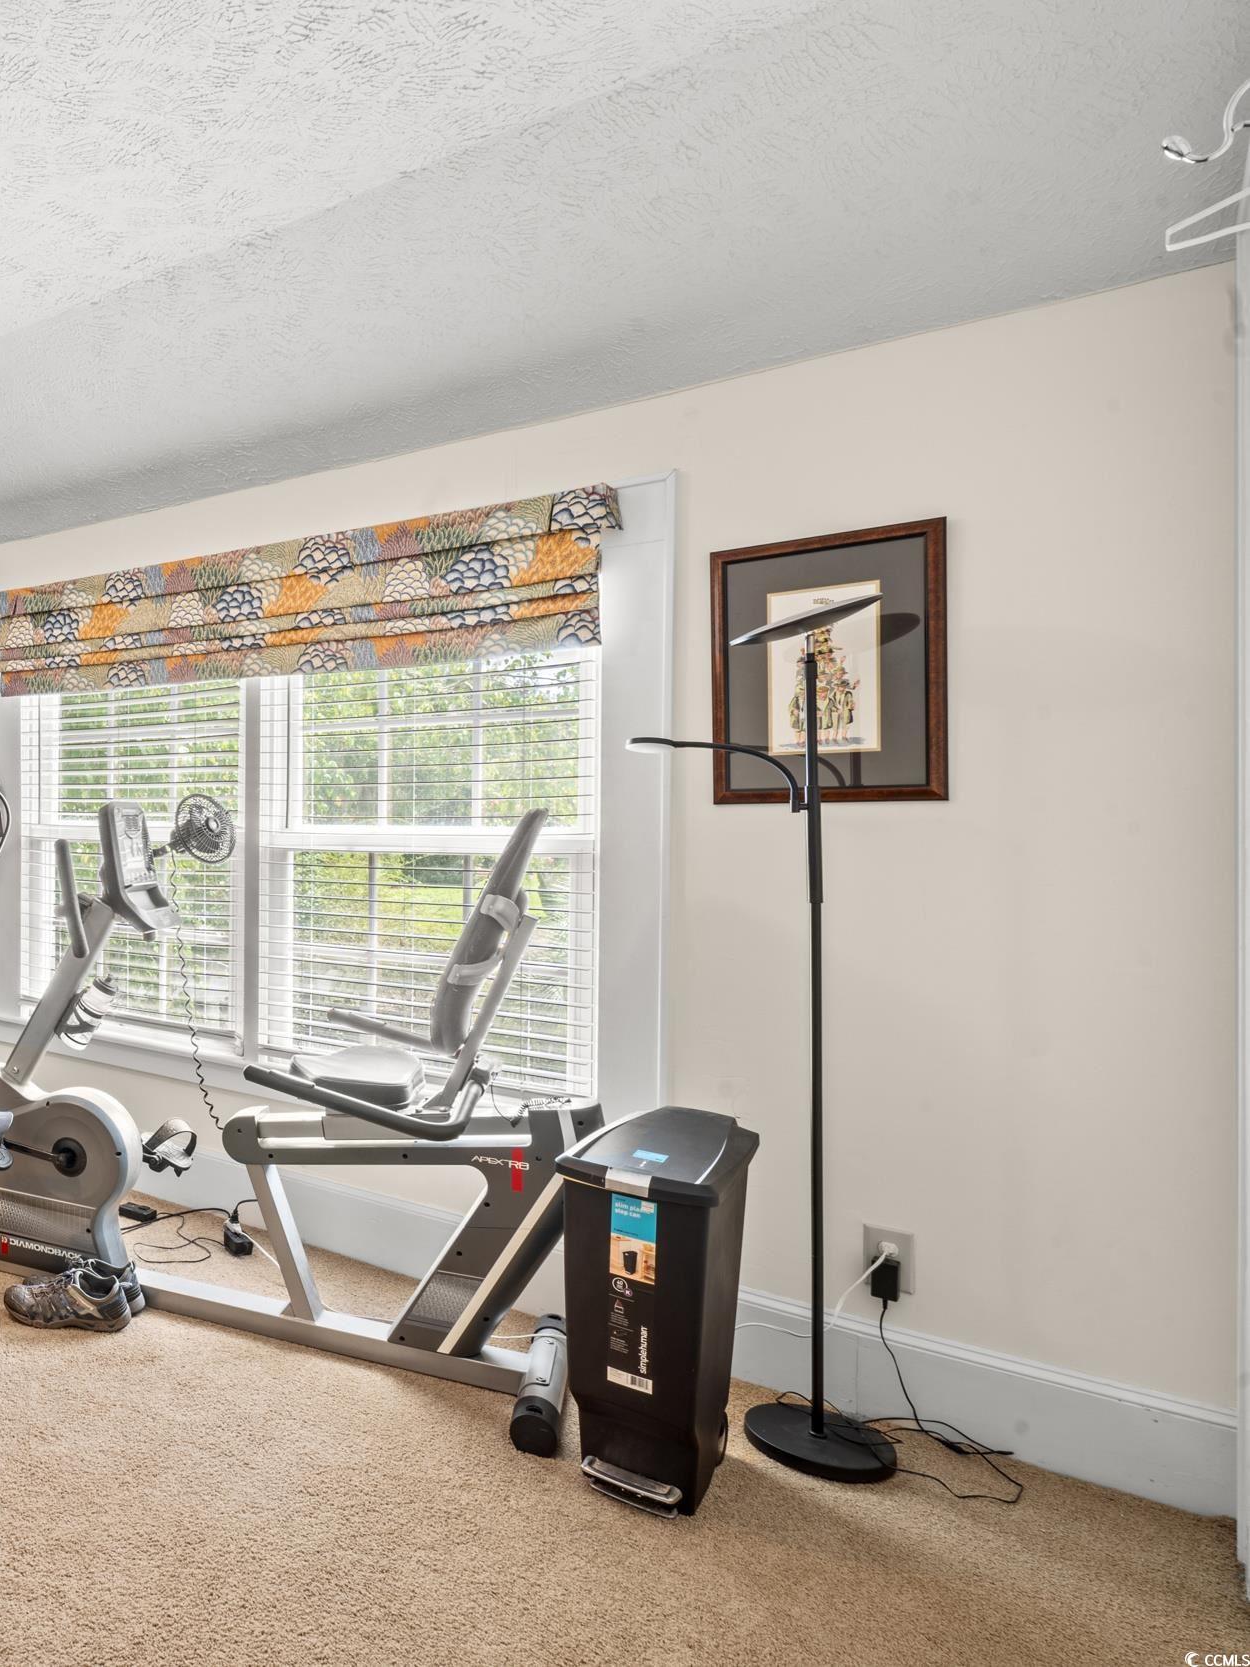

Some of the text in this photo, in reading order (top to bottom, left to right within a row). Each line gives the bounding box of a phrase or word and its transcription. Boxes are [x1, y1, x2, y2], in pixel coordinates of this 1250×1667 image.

[471, 1155, 504, 1166] APEX
[615, 1202, 629, 1210] slim
[615, 1208, 629, 1216] step
[9, 1239, 82, 1259] DIAMONDBACK
[638, 1326, 648, 1374] simplehuman
